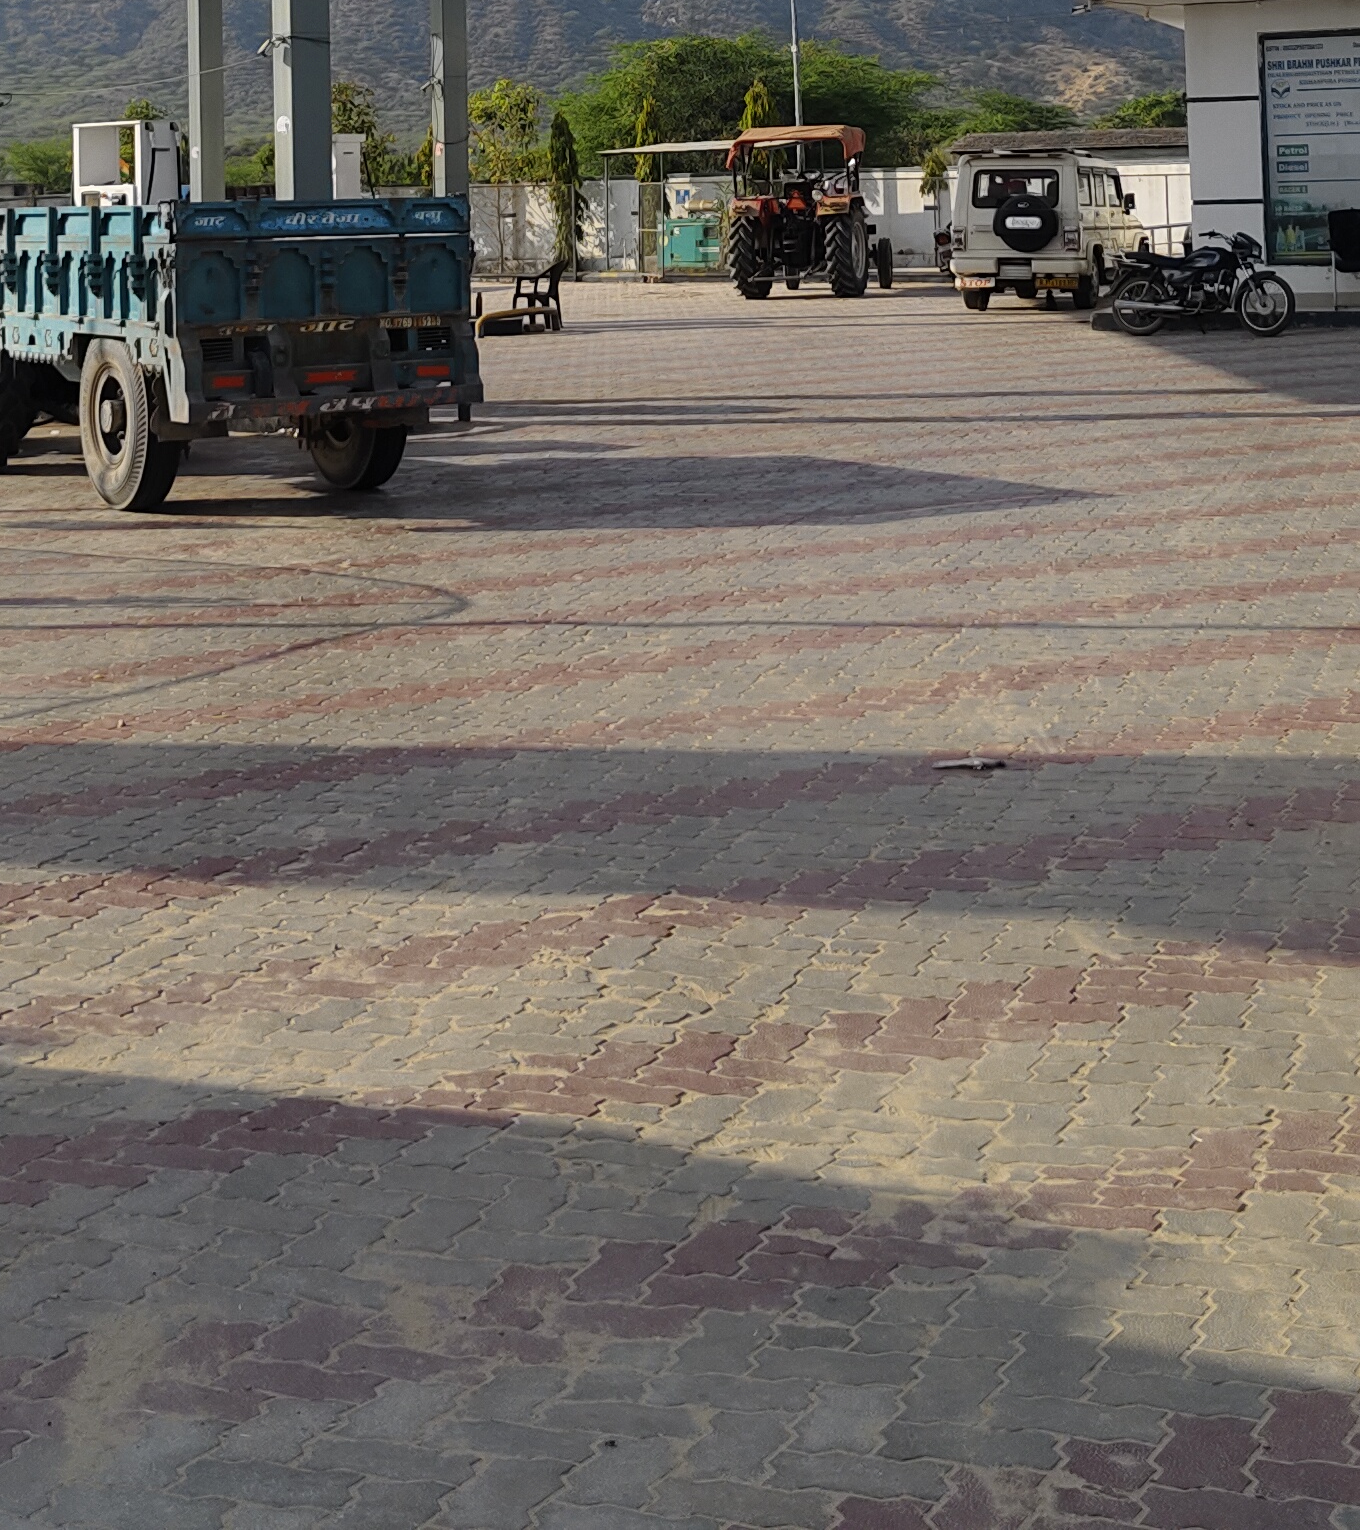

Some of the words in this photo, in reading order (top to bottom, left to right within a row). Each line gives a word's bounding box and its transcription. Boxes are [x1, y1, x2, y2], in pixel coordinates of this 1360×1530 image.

[1267, 60, 1285, 70] SHRI
[1287, 59, 1314, 69] BRAHM
[1315, 57, 1351, 68] PUSHKAR
[1278, 144, 1308, 155] Petrol
[1278, 162, 1308, 172] Diesel
[321, 211, 361, 224] तेजा
[960, 278, 991, 287] STOP
